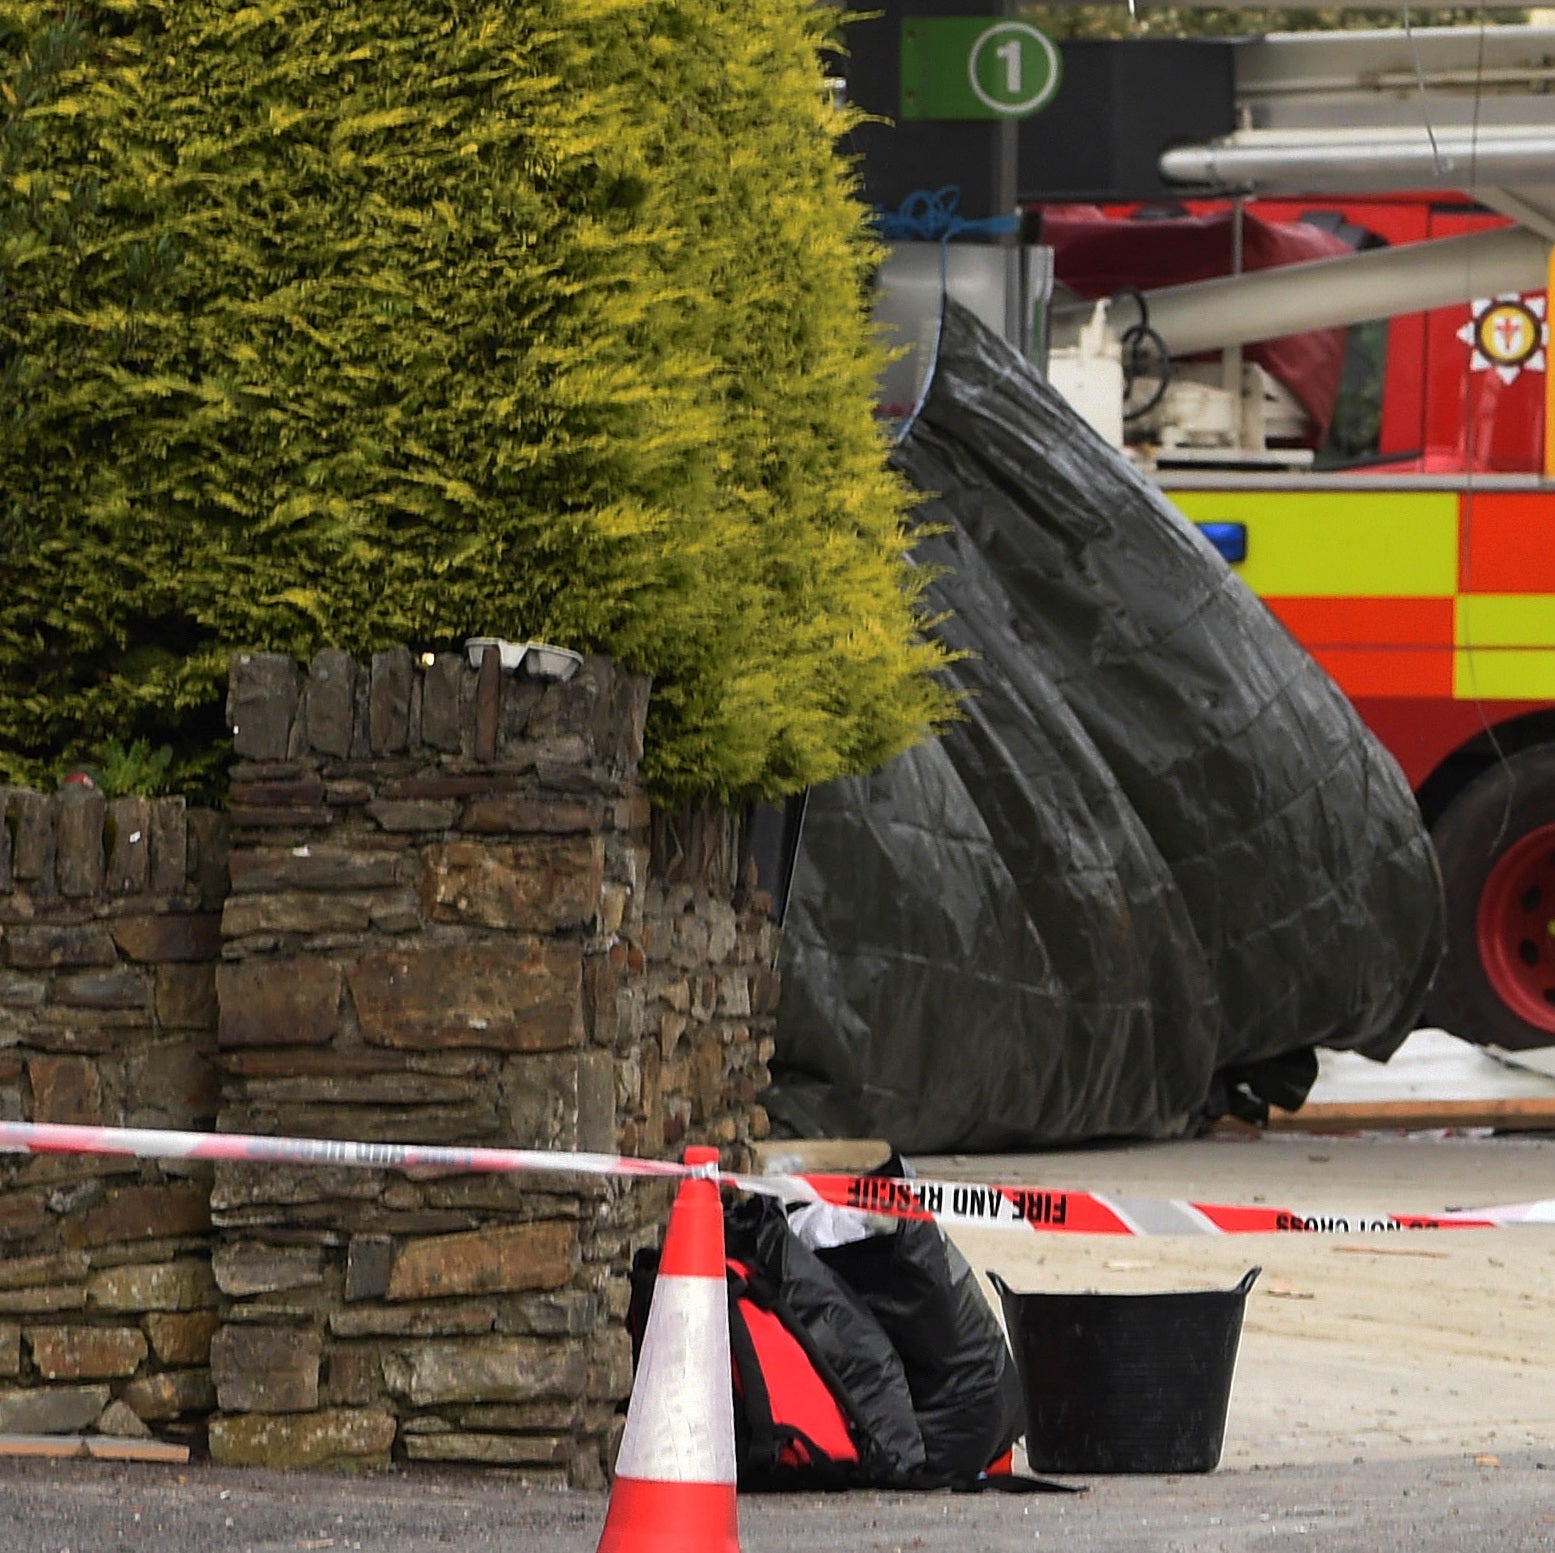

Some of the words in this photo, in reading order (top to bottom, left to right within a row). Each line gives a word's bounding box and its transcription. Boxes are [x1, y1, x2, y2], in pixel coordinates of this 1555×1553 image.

[996, 41, 1022, 94] 1
[848, 1178, 943, 1213] RESCUE
[953, 1186, 1003, 1221] AND
[1012, 1190, 1067, 1224] FIRE
